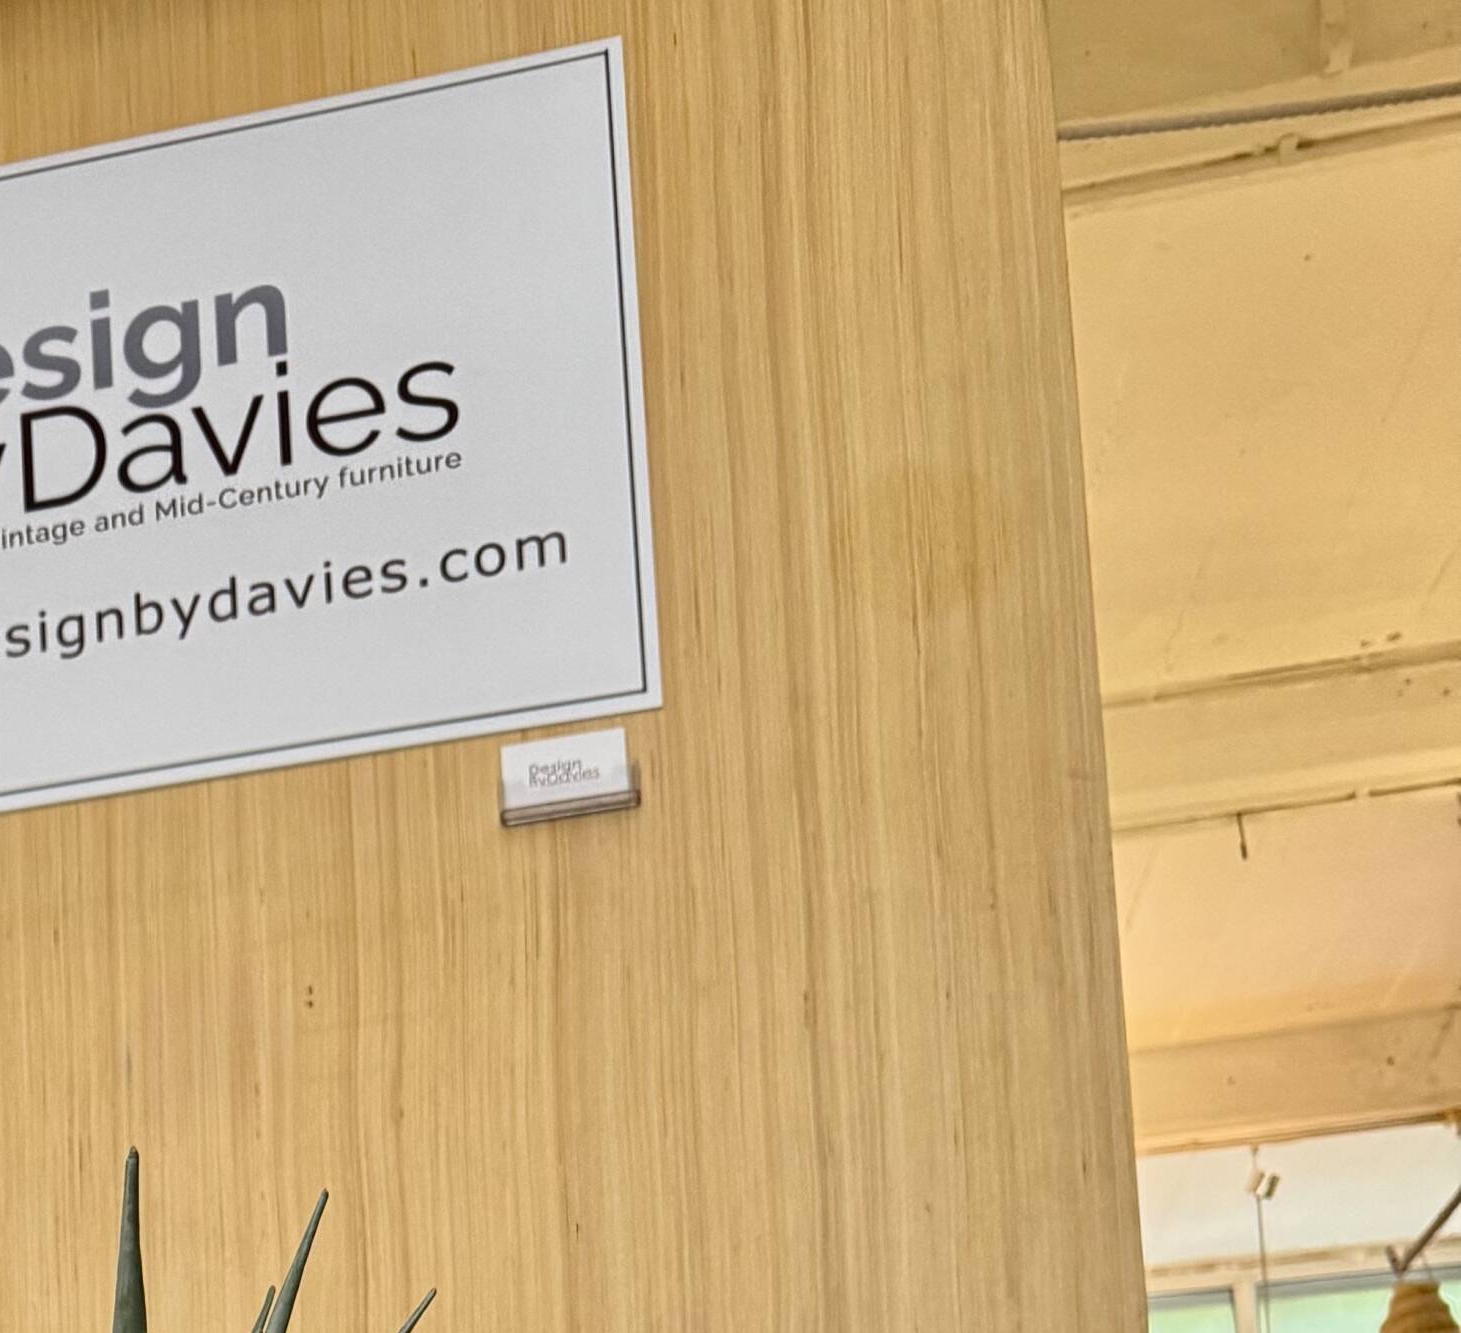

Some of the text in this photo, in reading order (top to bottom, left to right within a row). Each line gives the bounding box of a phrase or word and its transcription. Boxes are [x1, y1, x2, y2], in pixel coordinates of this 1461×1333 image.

[94, 503, 145, 533] and
[154, 475, 330, 523] Mid-Century
[338, 451, 463, 489] furniture
